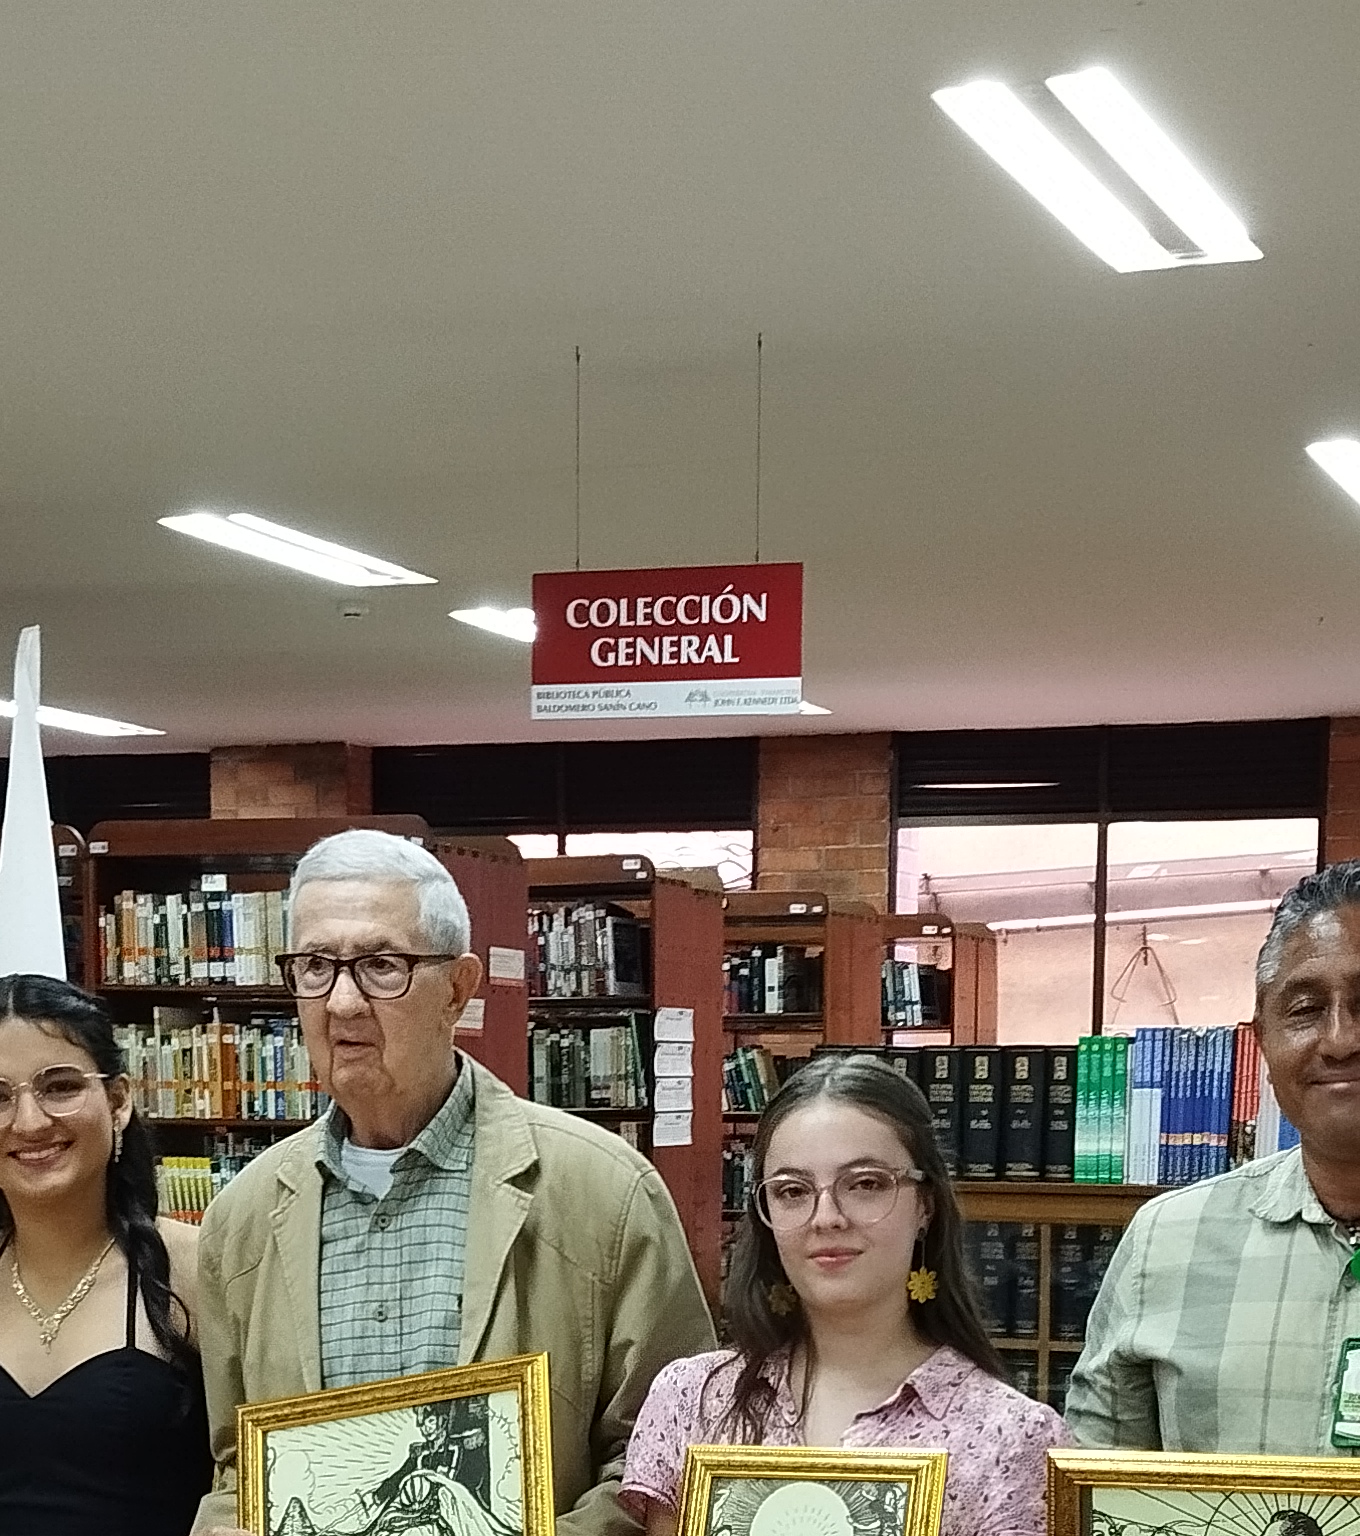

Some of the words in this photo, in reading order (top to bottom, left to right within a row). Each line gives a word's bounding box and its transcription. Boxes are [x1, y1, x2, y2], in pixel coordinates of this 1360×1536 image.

[565, 583, 768, 629] COLECCIÓN
[590, 634, 740, 667] GENERAL
[536, 690, 589, 700] BIBLIOTECA
[592, 688, 632, 699] PÚBLICA
[536, 703, 596, 713] BALDOMERO
[628, 701, 658, 711] CANO
